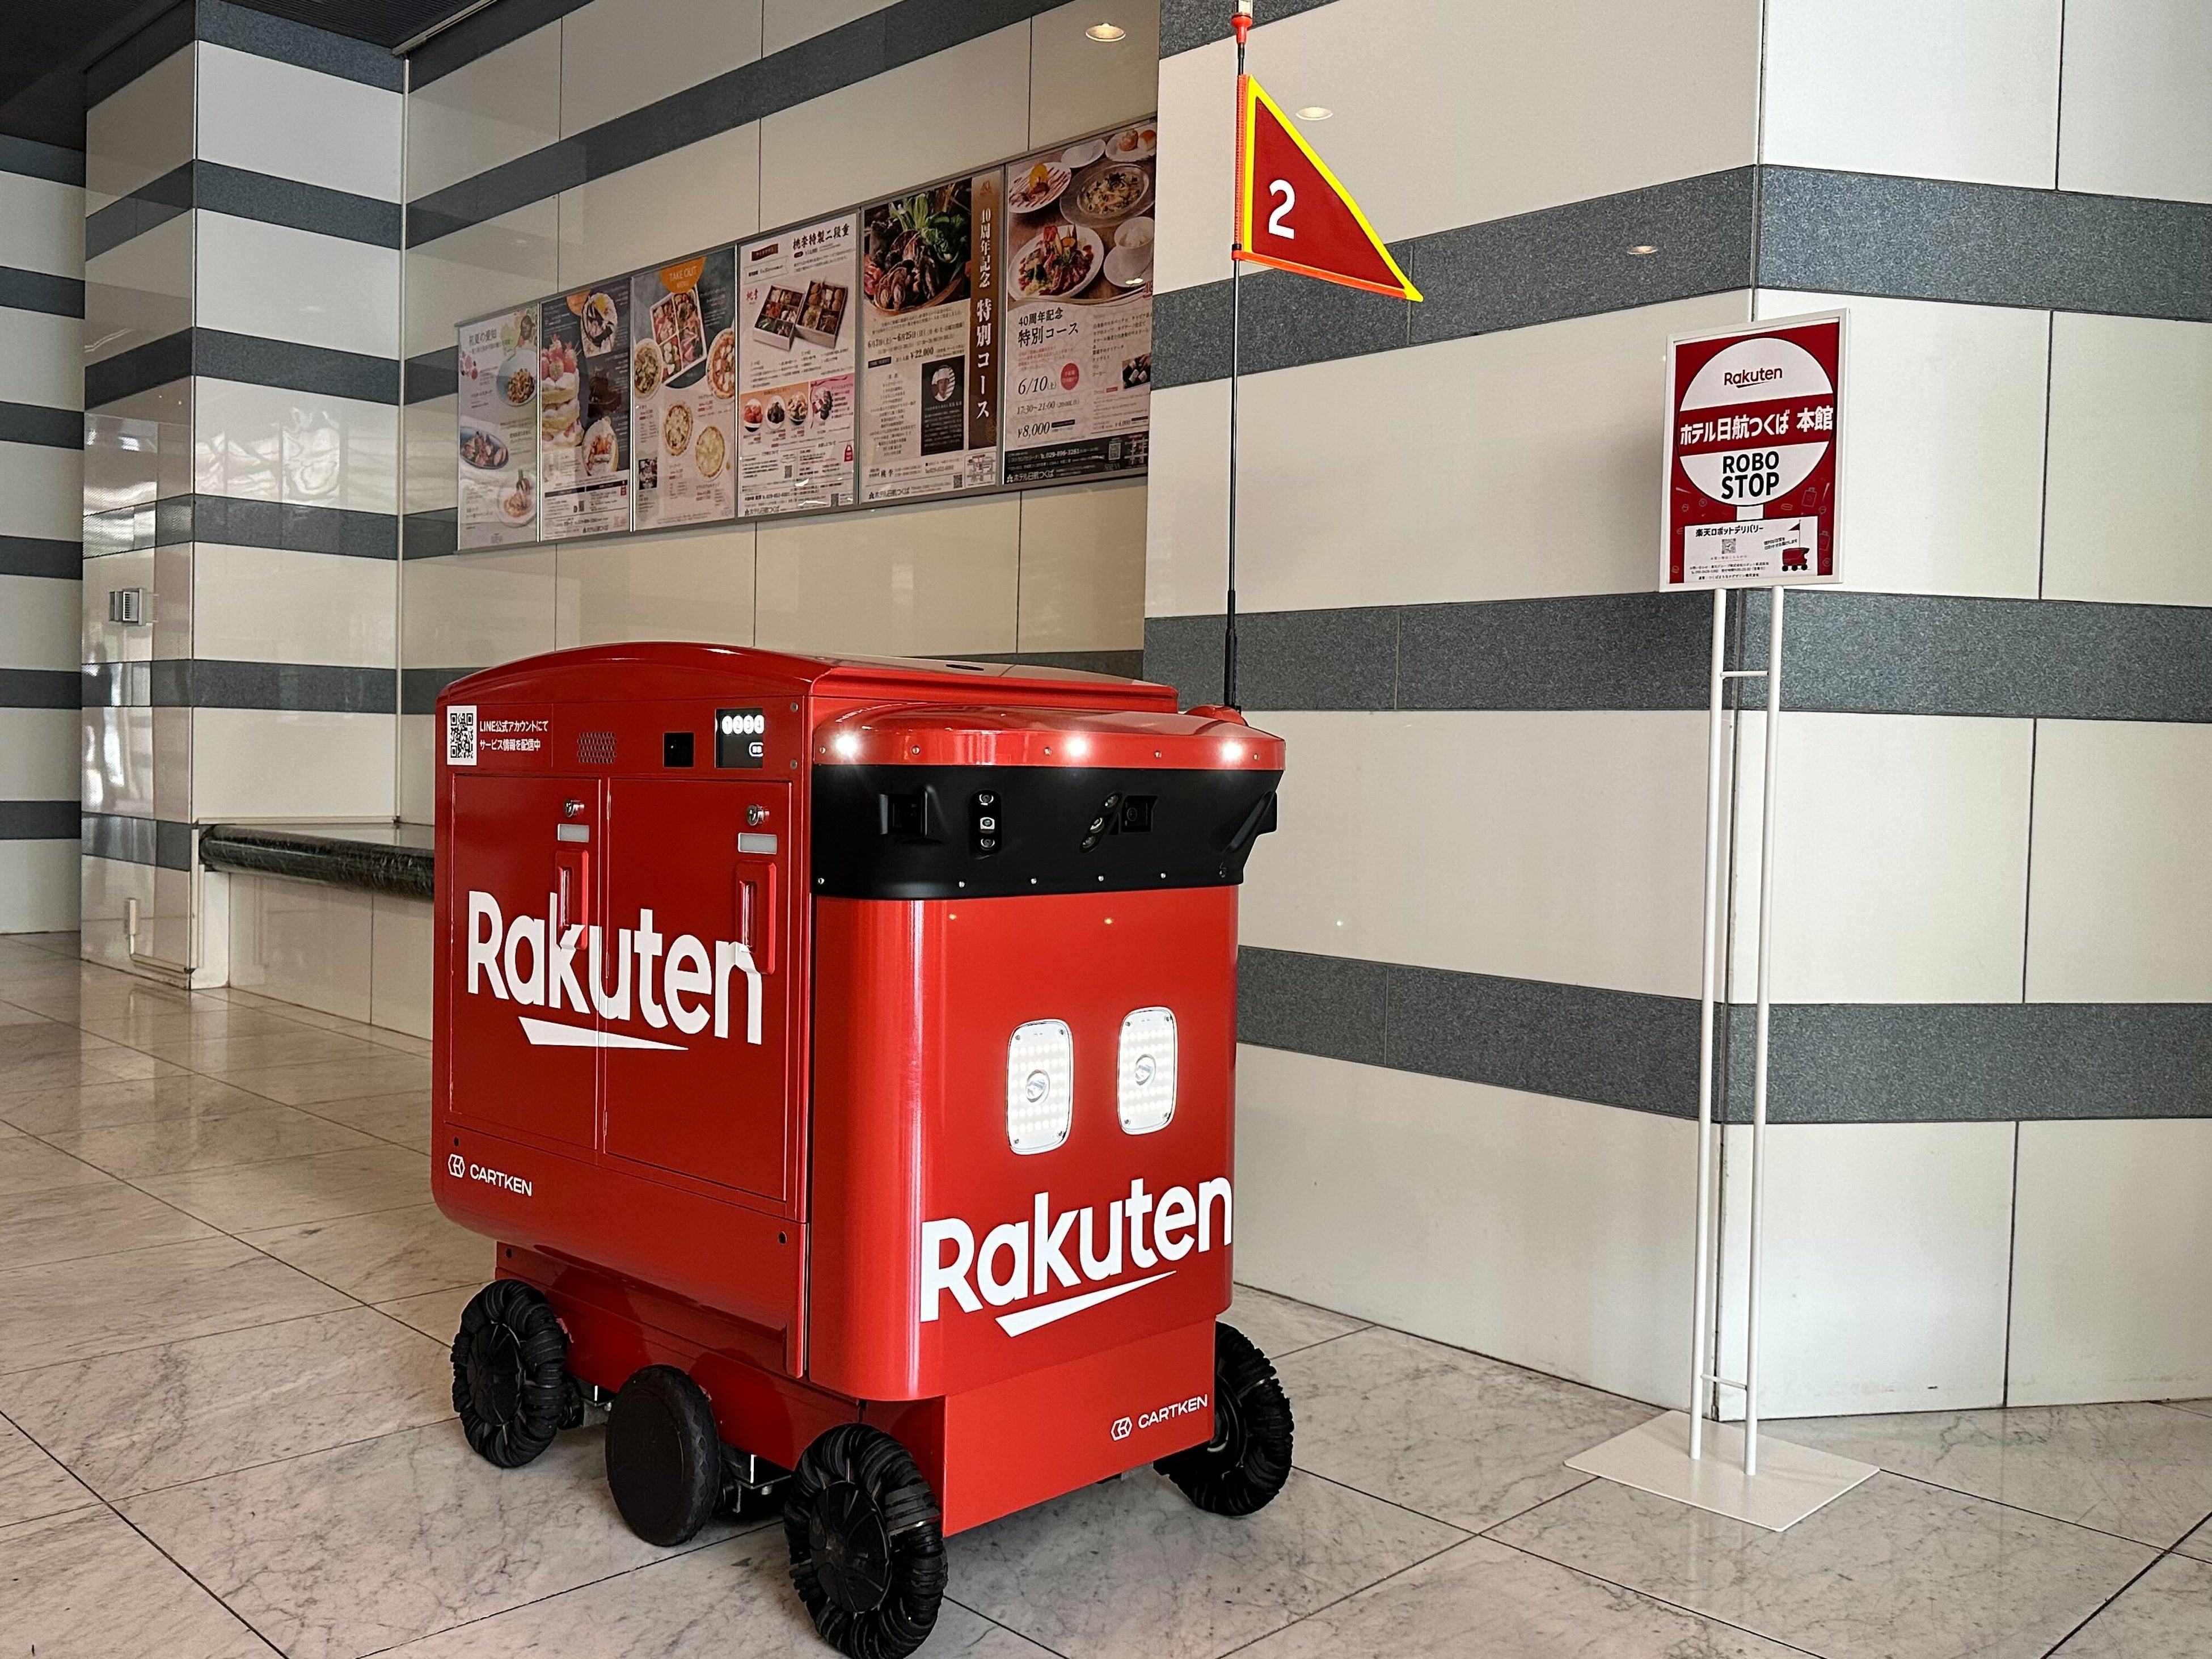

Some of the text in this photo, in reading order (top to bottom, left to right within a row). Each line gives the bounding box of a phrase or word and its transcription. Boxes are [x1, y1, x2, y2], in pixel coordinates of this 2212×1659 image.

[1269, 179, 1295, 239] 2
[683, 265, 698, 277] OUT
[976, 208, 993, 420] 40周年記念 特別コース
[1018, 307, 1063, 327] 40周年記念
[1018, 322, 1078, 348] 特別コース
[1724, 367, 1783, 386] Rakuten
[1679, 404, 1834, 445] ホテル日航つくば 本館
[1722, 450, 1780, 474] ROBO
[1721, 471, 1780, 500] STOP
[1695, 524, 1764, 538] 楽天ロボットデリバリー
[479, 720, 549, 733] LINE公式アカウントにて
[479, 738, 541, 752] サービス情報を配信中
[468, 890, 762, 1045] Rakuten
[470, 1164, 532, 1196] CARTKEN
[920, 1176, 1232, 1323] Rakuten
[1138, 1394, 1208, 1429] CARTKEN
